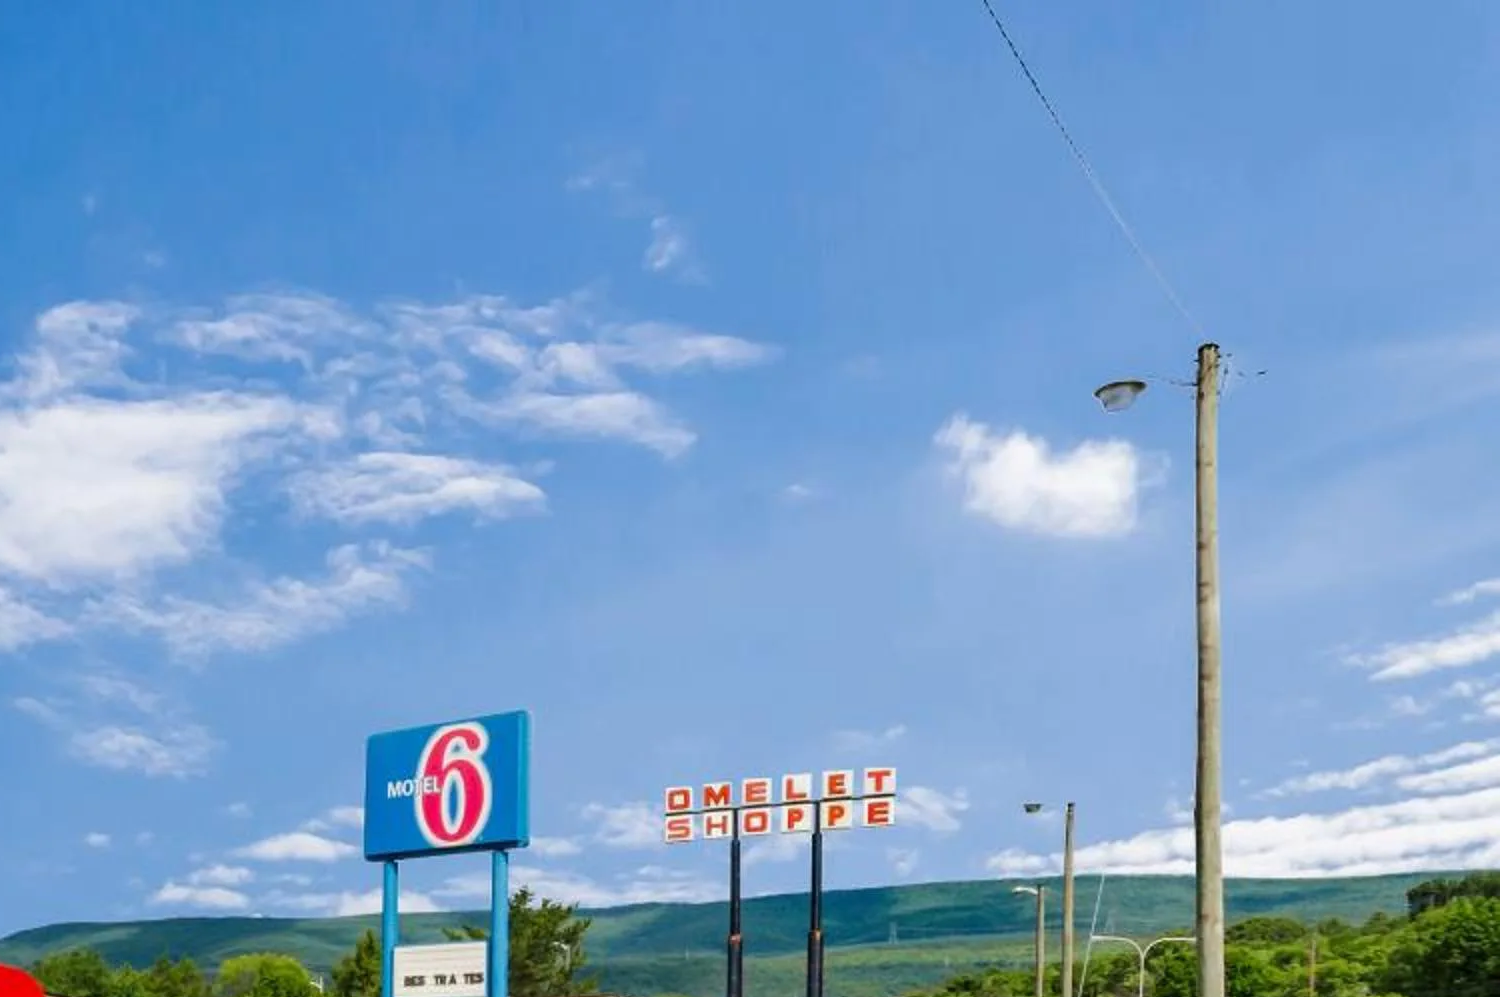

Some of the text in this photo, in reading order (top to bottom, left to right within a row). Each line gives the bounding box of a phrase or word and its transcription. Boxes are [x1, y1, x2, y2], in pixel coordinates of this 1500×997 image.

[387, 722, 492, 846] MOTEL 6
[667, 769, 892, 811] OMELET
[666, 801, 891, 839] SHOPPE
